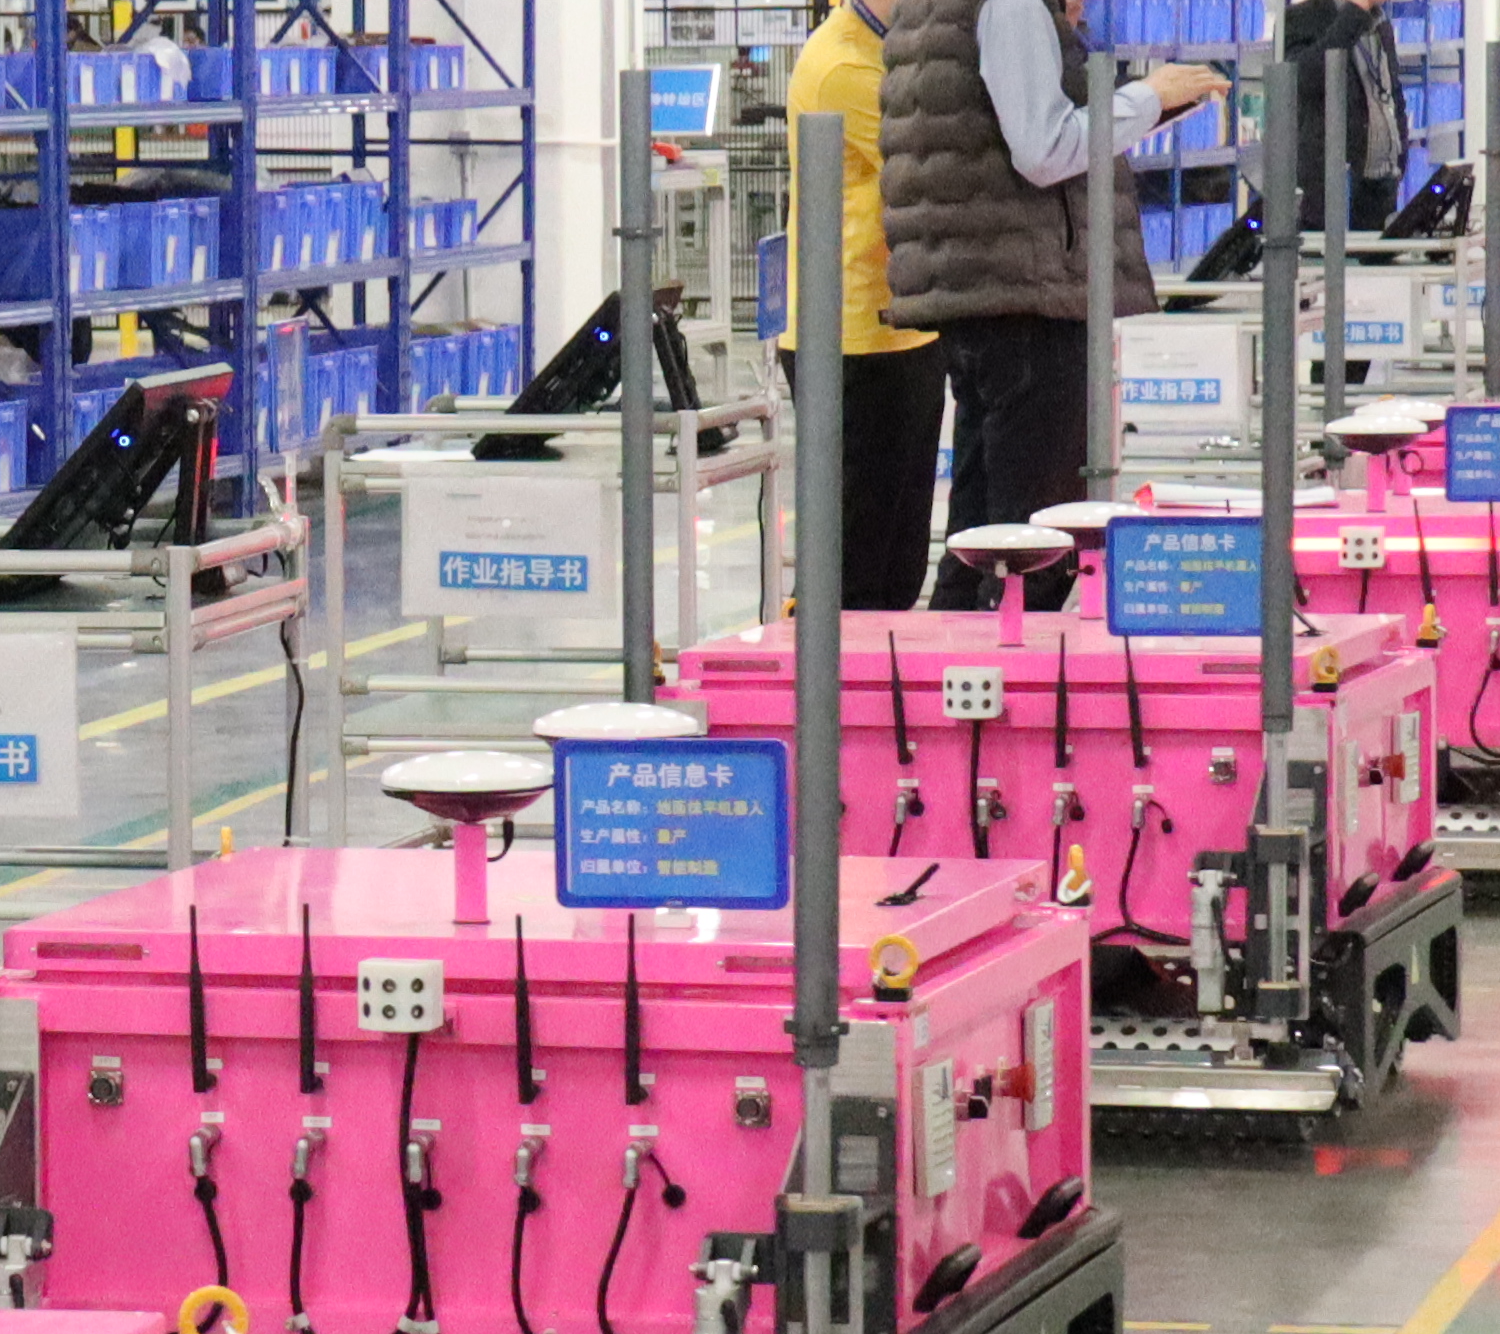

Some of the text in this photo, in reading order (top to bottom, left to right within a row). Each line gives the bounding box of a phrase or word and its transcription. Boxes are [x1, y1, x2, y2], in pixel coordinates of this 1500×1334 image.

[1122, 381, 1218, 402] 作业指导书
[1143, 533, 1237, 552] 产品信息卡
[443, 555, 584, 588] 作业指导书
[607, 762, 734, 789] 产品信息卡
